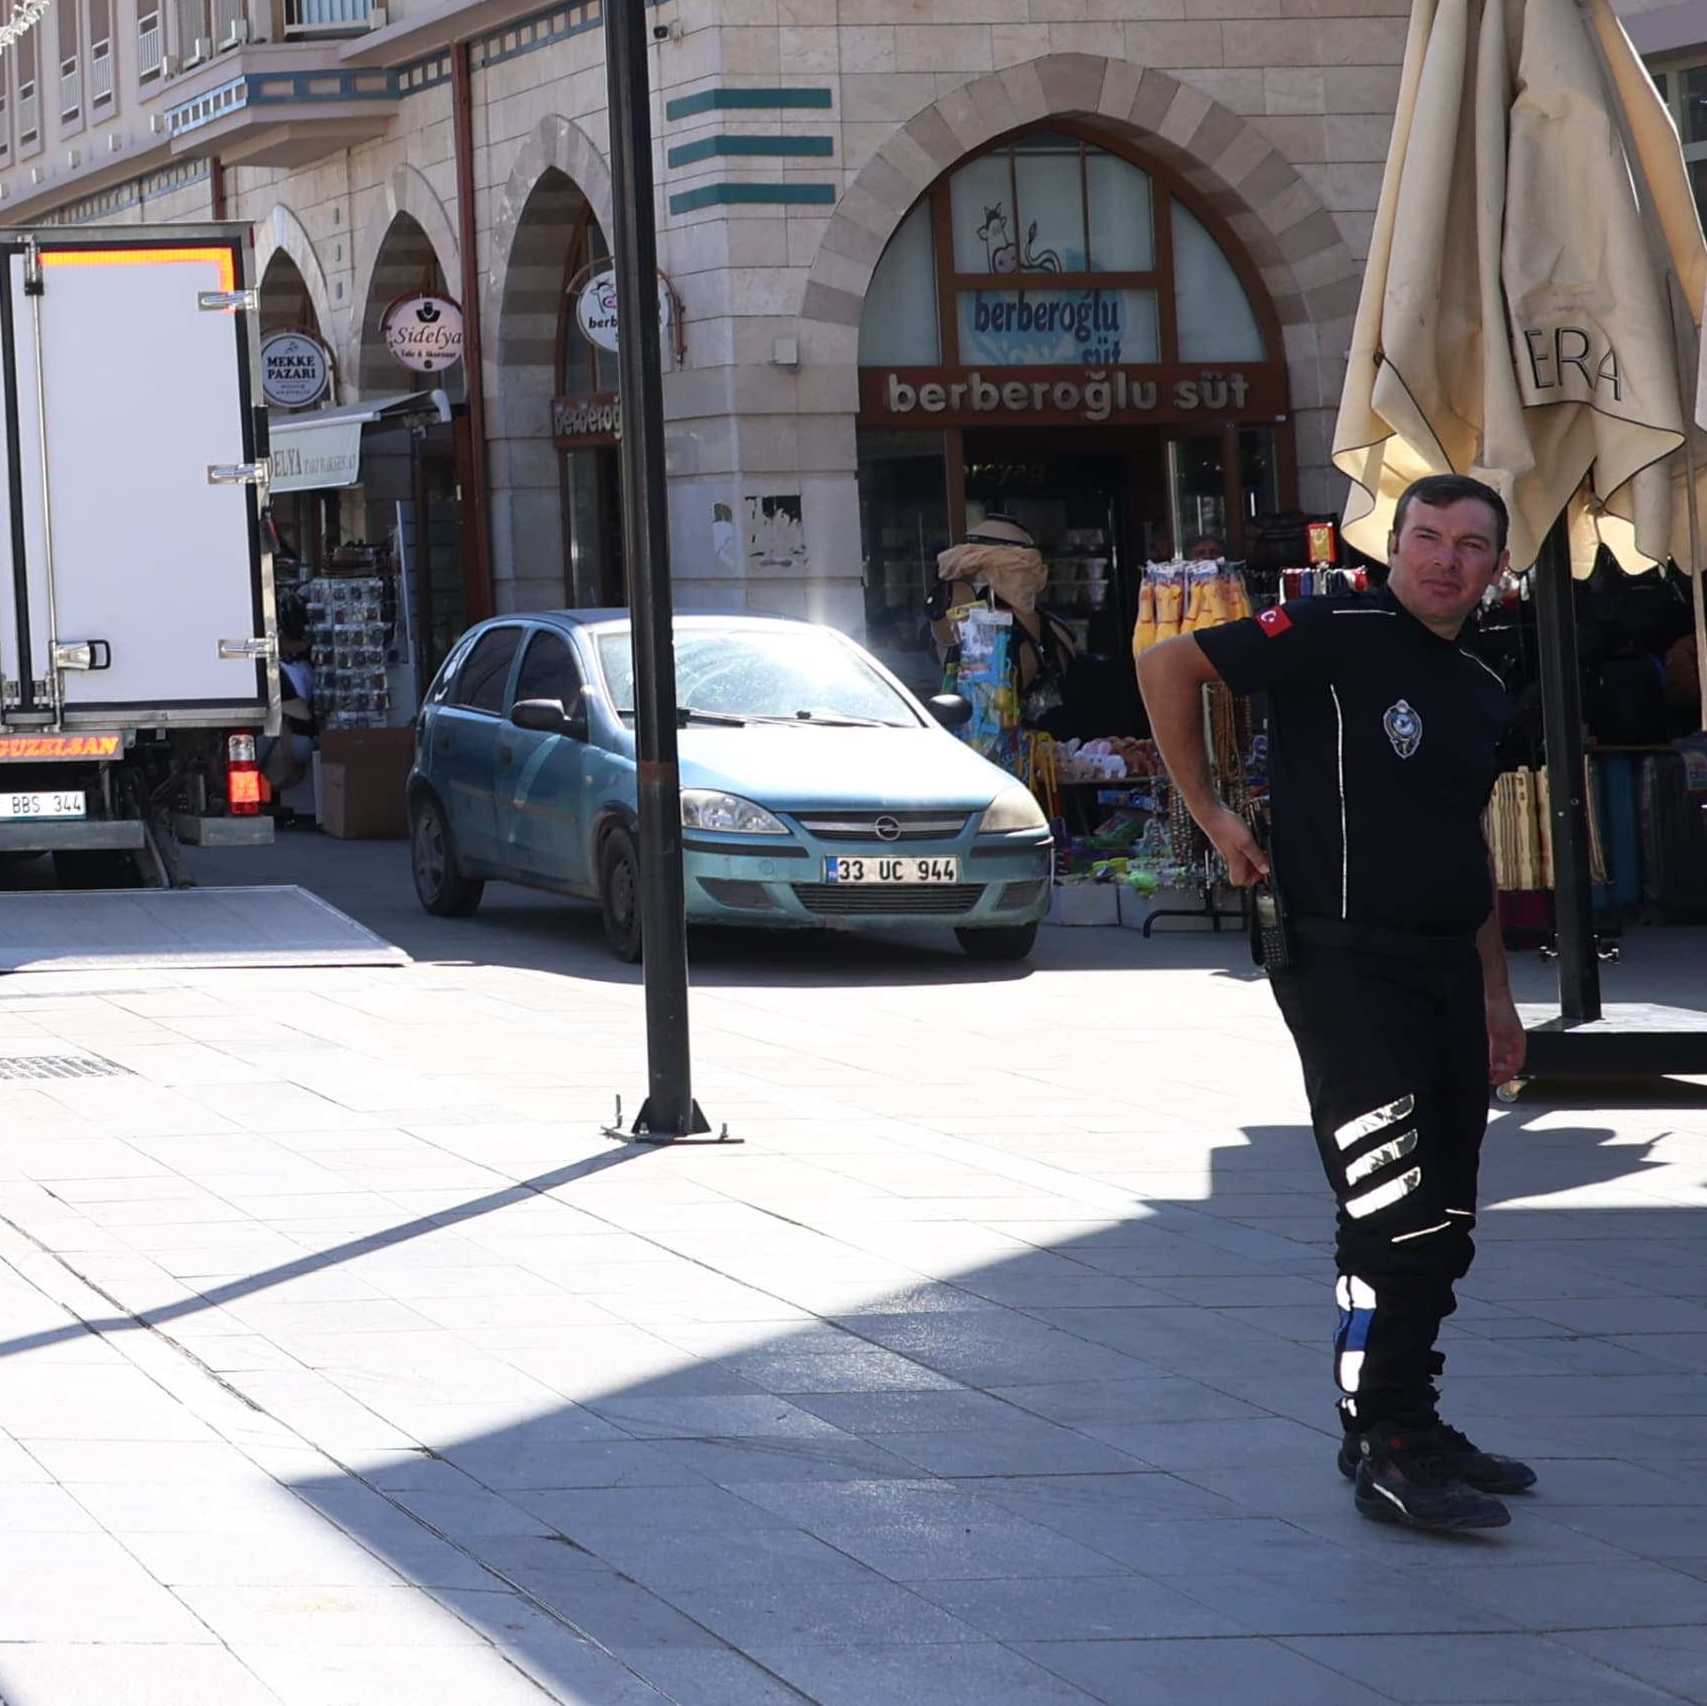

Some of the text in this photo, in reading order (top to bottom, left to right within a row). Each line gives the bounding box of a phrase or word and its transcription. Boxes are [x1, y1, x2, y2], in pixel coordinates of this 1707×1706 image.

[974, 289, 1120, 341] berberoğlu
[394, 326, 463, 350] Sidelya
[267, 355, 315, 367] MEKKE
[267, 368, 316, 380] PAZARI
[888, 370, 1250, 420] berberoğlu süt
[11, 794, 41, 815] BBS
[53, 794, 82, 813] 344
[838, 859, 955, 881] 33 UC 944
